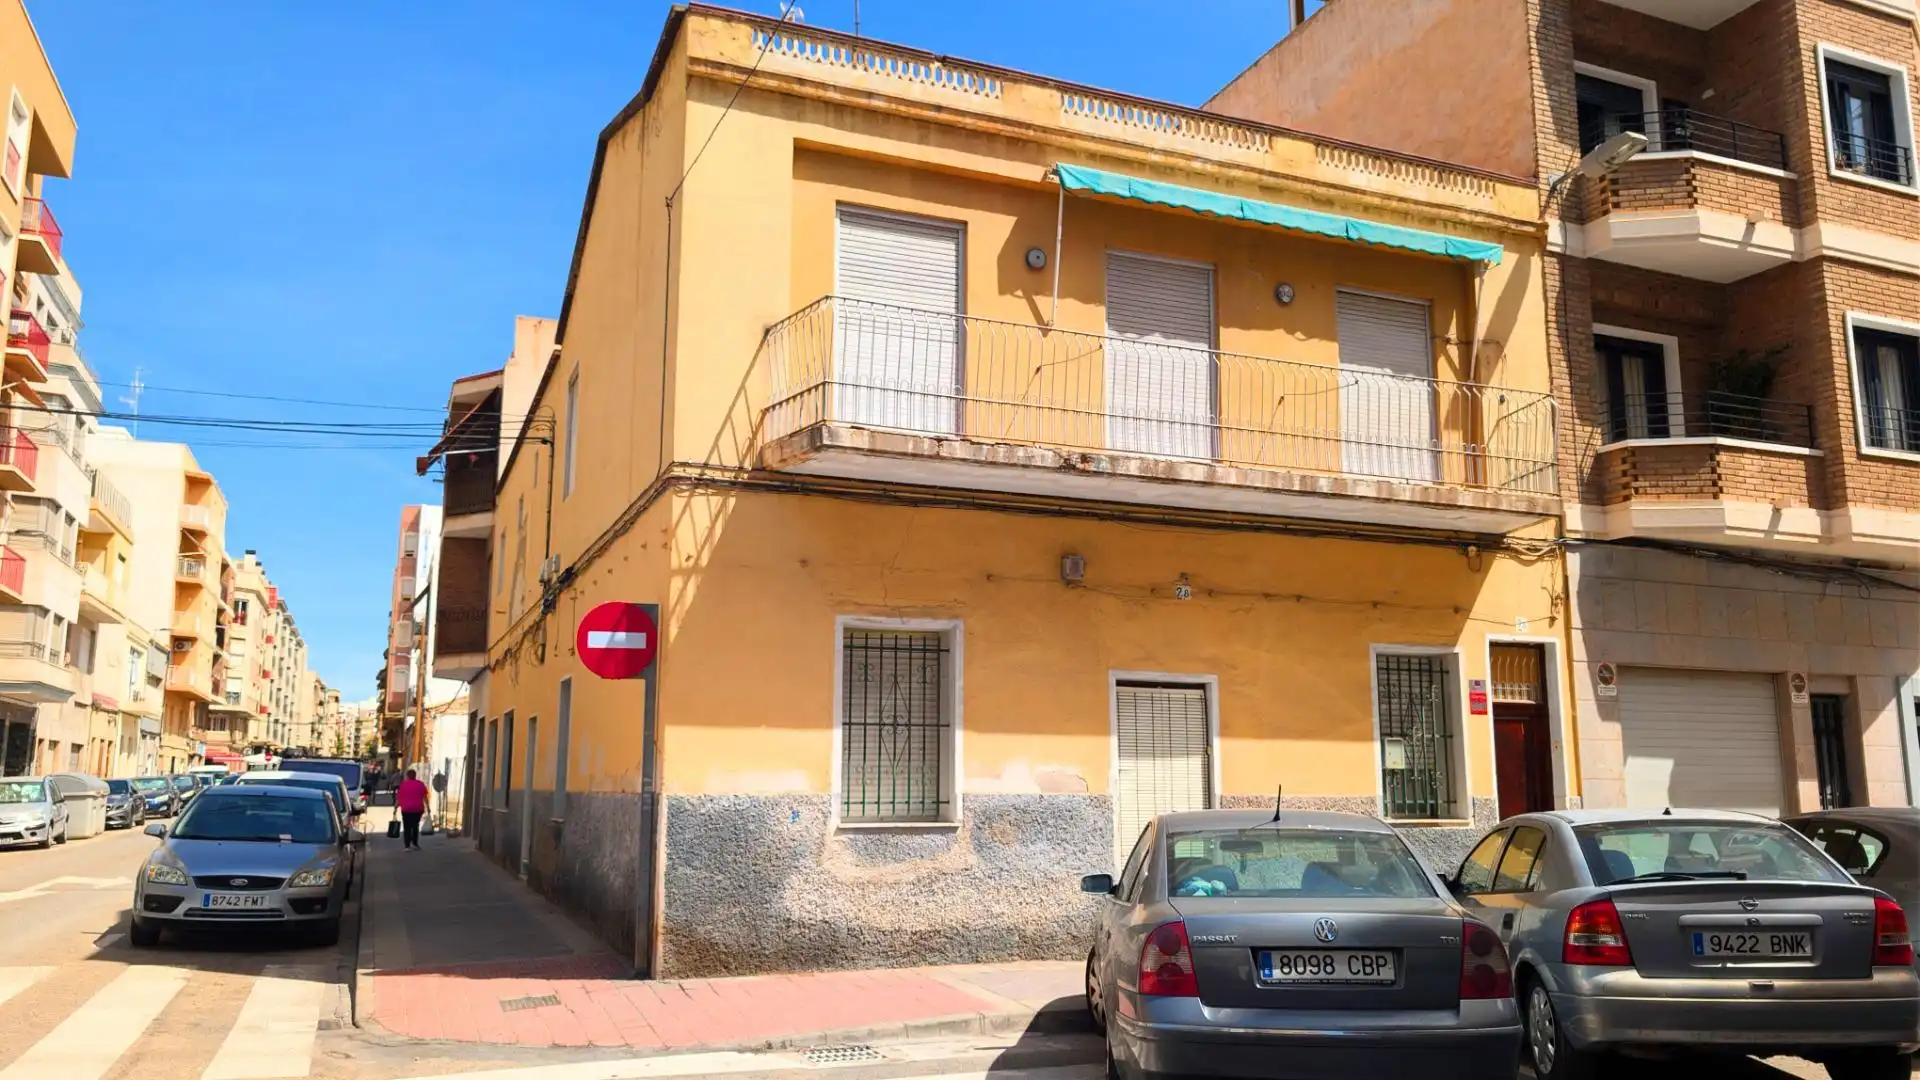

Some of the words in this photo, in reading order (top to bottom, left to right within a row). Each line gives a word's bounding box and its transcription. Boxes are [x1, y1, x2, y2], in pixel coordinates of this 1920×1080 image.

[212, 895, 240, 907] 8742
[243, 895, 265, 906] FMT
[1192, 934, 1238, 943] PASSAT
[1710, 935, 1760, 953] 9422
[1770, 935, 1807, 953] BNK
[1280, 954, 1336, 976] 8098
[1347, 954, 1388, 976] CBP
